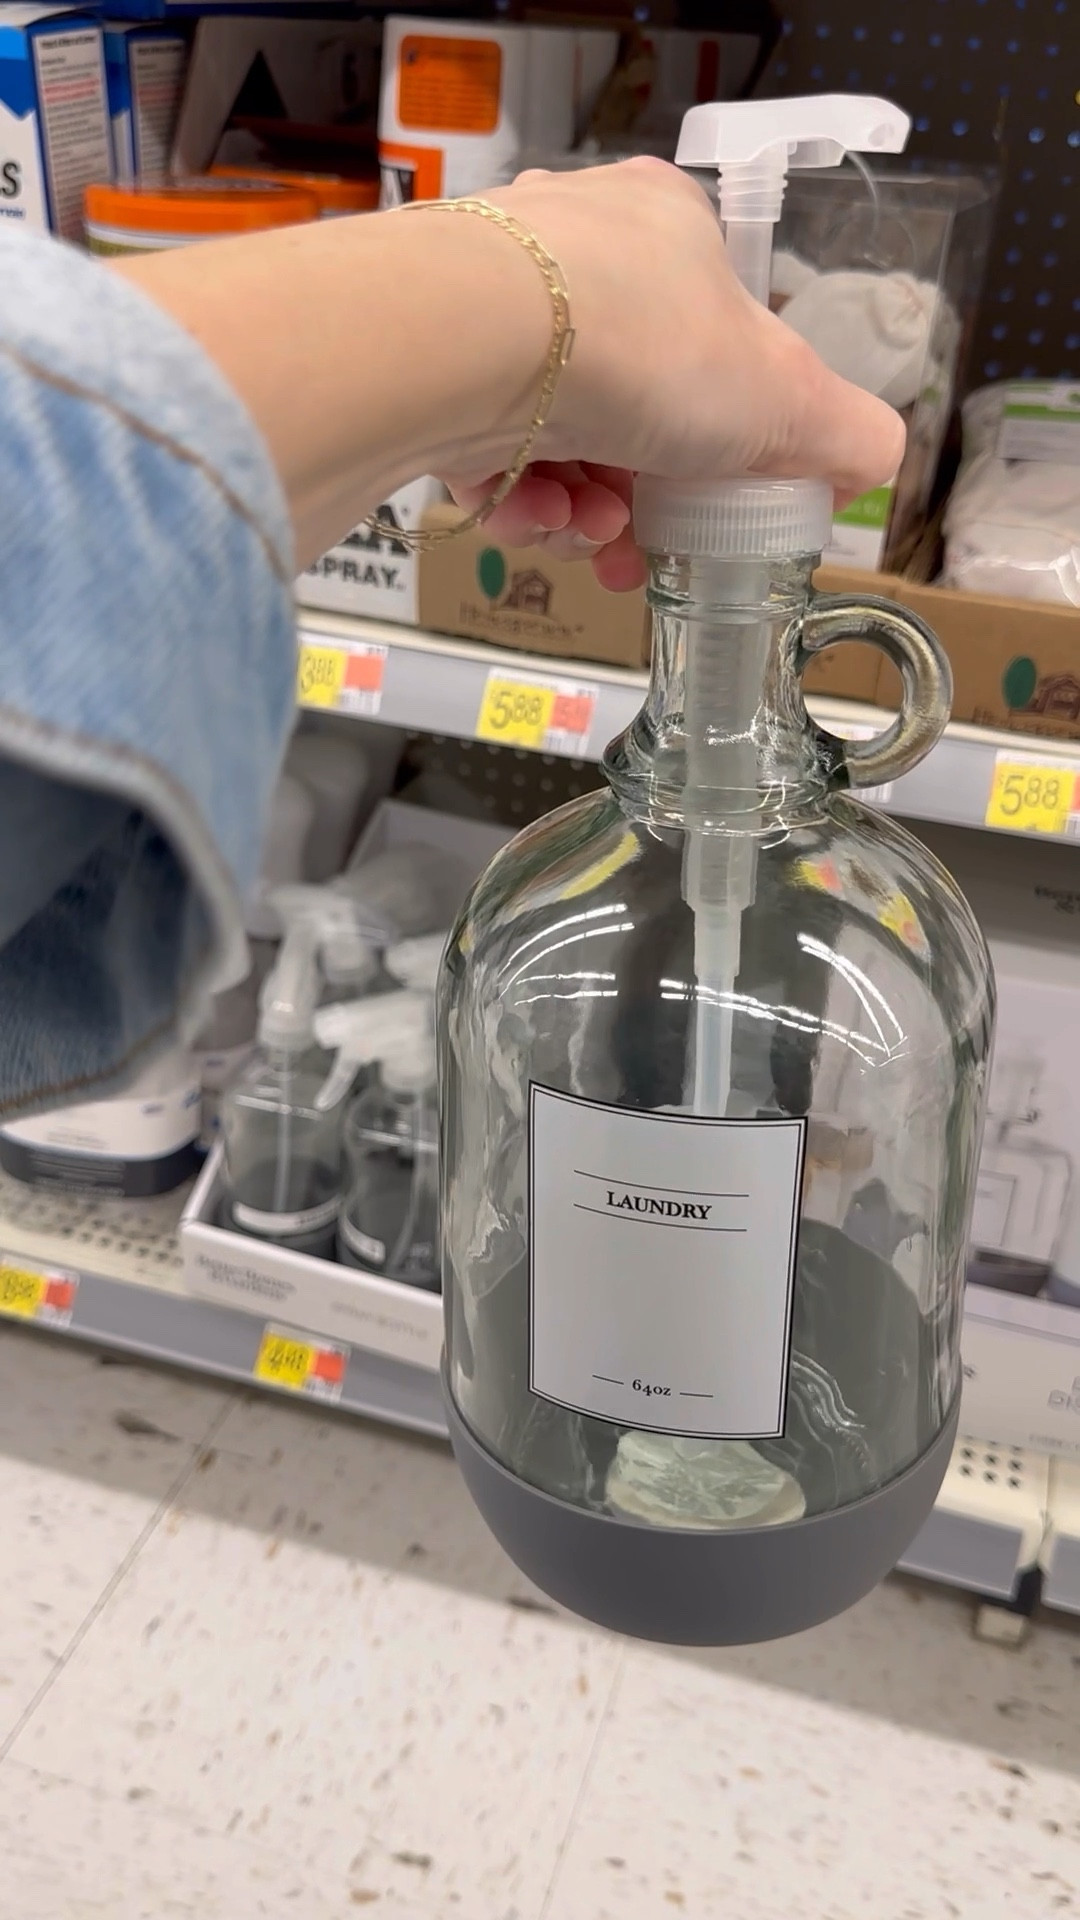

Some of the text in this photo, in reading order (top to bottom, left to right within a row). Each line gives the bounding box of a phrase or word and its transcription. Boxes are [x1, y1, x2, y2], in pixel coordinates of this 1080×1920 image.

[0, 160, 19, 198] S
[606, 1190, 712, 1220] LAUNDRY
[632, 1378, 671, 1397] 64oz
